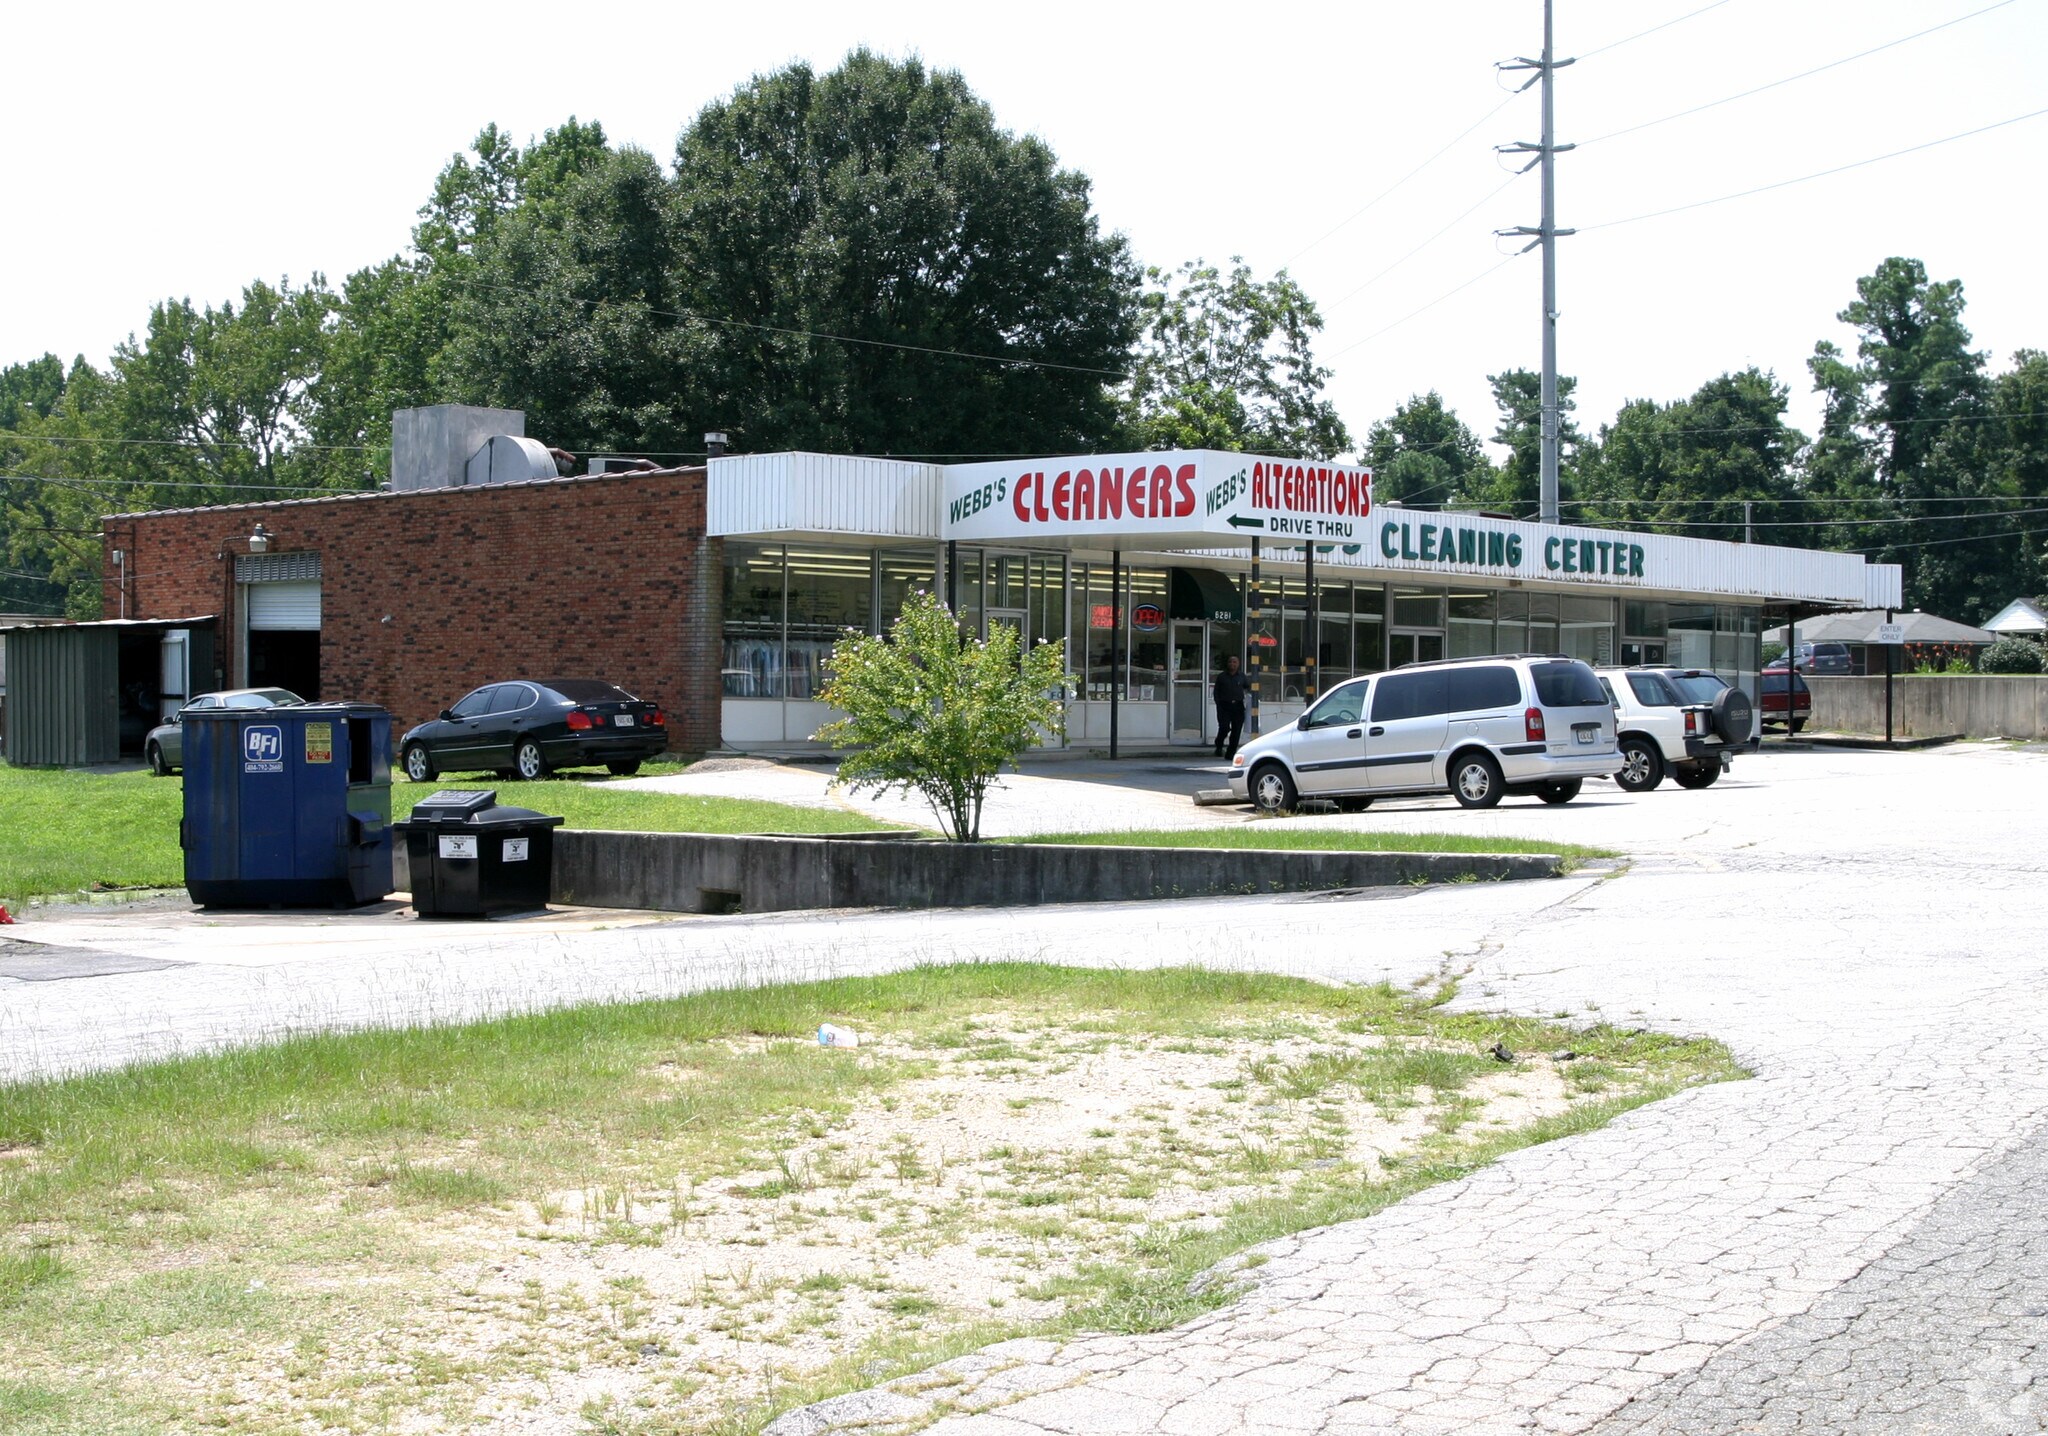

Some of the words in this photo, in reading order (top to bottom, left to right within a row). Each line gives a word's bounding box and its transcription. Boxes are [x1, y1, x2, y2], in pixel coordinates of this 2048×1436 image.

[950, 476, 1006, 525] WEBB'S
[1013, 464, 1196, 522] CLEANERS
[1206, 468, 1246, 518] WEBB'S
[1252, 461, 1370, 517] ALTERATIONS
[1270, 517, 1313, 534] DRIVE
[1317, 520, 1353, 538] THRU
[1381, 521, 1523, 568] CLEANING
[1544, 535, 1645, 578] CENTER
[1132, 609, 1165, 626] OPEN
[1214, 610, 1232, 620] 6281
[249, 732, 278, 755] BFI
